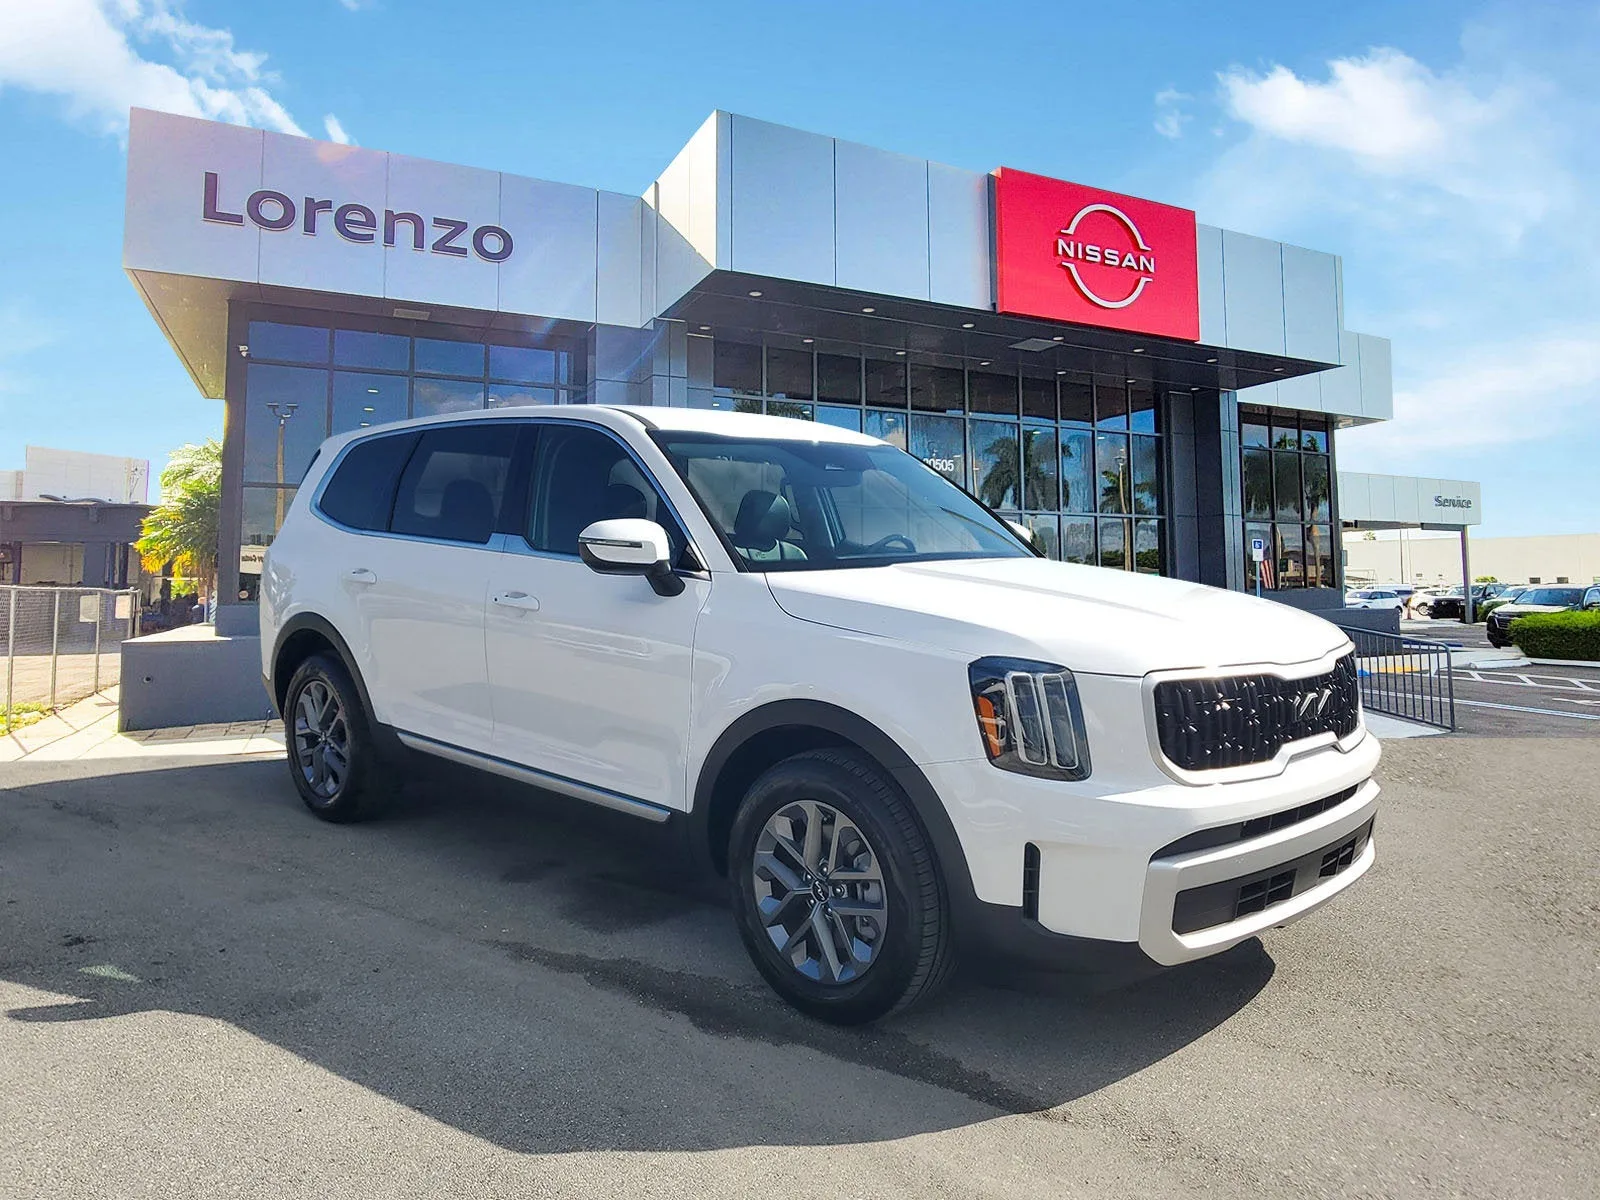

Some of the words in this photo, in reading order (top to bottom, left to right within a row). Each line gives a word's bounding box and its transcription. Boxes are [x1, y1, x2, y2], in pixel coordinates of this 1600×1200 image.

[203, 171, 514, 262] Lorenzo
[1057, 238, 1155, 273] NISSAN
[1434, 495, 1472, 509] Service
